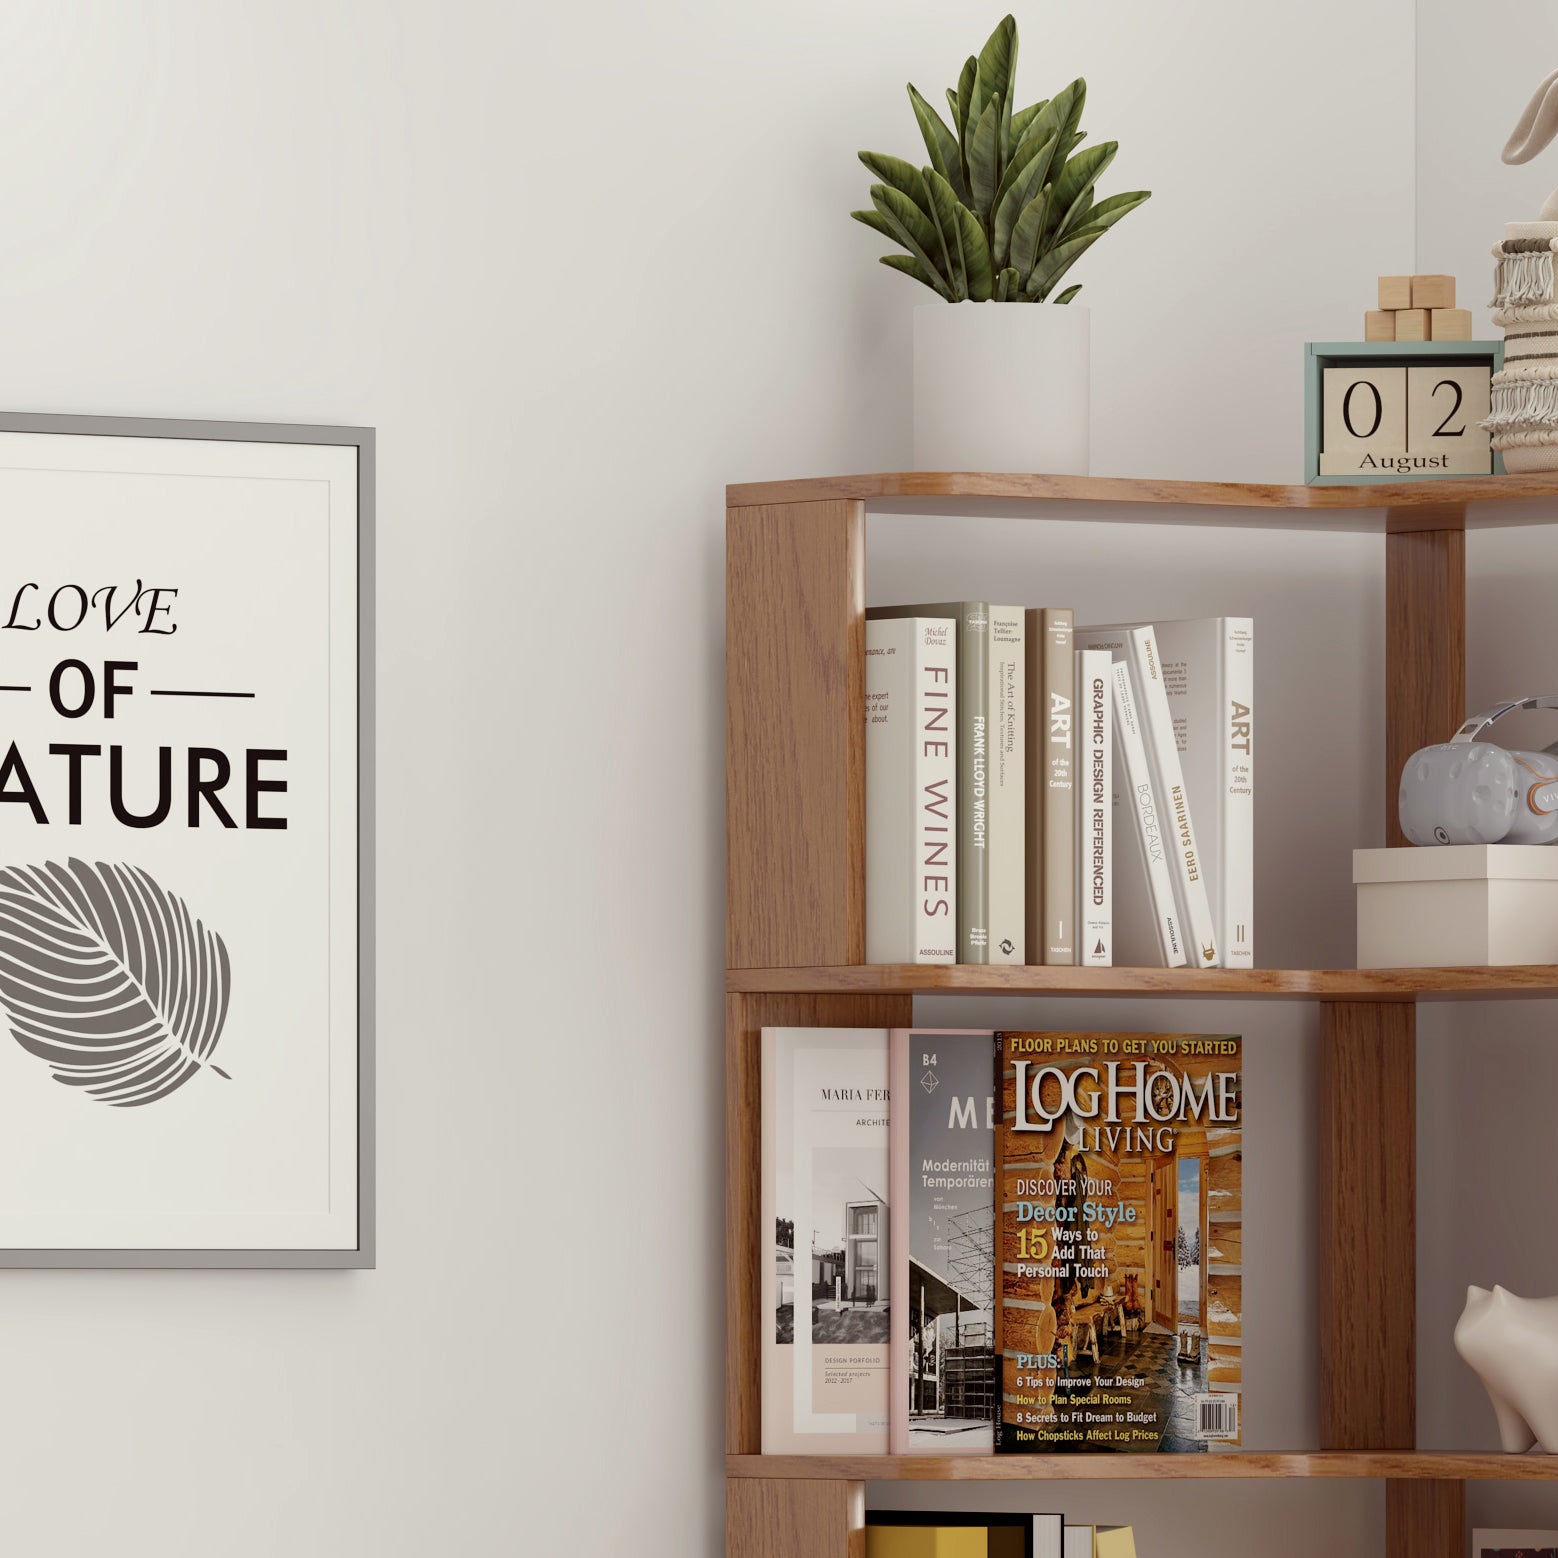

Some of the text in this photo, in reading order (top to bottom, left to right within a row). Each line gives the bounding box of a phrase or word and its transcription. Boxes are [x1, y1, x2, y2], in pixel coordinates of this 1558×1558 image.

[1342, 379, 1466, 438] 0 2
[1359, 452, 1450, 474] August
[1, 578, 179, 635] LOVE
[924, 626, 948, 637] Michel
[924, 636, 947, 646] Dovaz
[1144, 640, 1158, 680] ASSOULINE
[49, 658, 138, 719] OF
[1005, 661, 1016, 753] The Art Knitting
[1050, 692, 1071, 749] ART
[1231, 700, 1250, 756] ART
[973, 716, 986, 849] FRANK LLOYD WRIGHT
[1049, 780, 1073, 790] Century
[1234, 775, 1247, 784] 20th
[924, 666, 949, 917] FINE WINES
[1093, 678, 1104, 906] GRAPHIC DESIGN REFERENCED
[1229, 786, 1252, 796] Century
[1137, 783, 1164, 863] BORDEAUX
[1171, 785, 1199, 882] EERO SAARINEN
[1166, 917, 1179, 955] ASSOULINE
[1010, 1038, 1237, 1055] FLOOR PLANS TO GET YOU STARTED
[922, 1053, 937, 1067] B4
[821, 1088, 862, 1101] MARIA
[922, 1158, 990, 1172] Modernität
[1016, 1179, 1113, 1196] DISCOVER YOUR
[1016, 1201, 1137, 1228] Decor Style
[1016, 1226, 1099, 1260] 15 Ways to
[1051, 1245, 1106, 1260] Add That
[1017, 1263, 1109, 1278] Personal Touch
[1016, 1354, 1062, 1369] PLUS:
[1025, 1376, 1145, 1389] Tips to Improve Your Design
[1016, 1394, 1132, 1407] How to Plan Special Rooms
[1025, 1412, 1157, 1425] Secrets to Fit Dream to Budget
[1016, 1430, 1159, 1443] How Chopsticks Affect Log Prices
